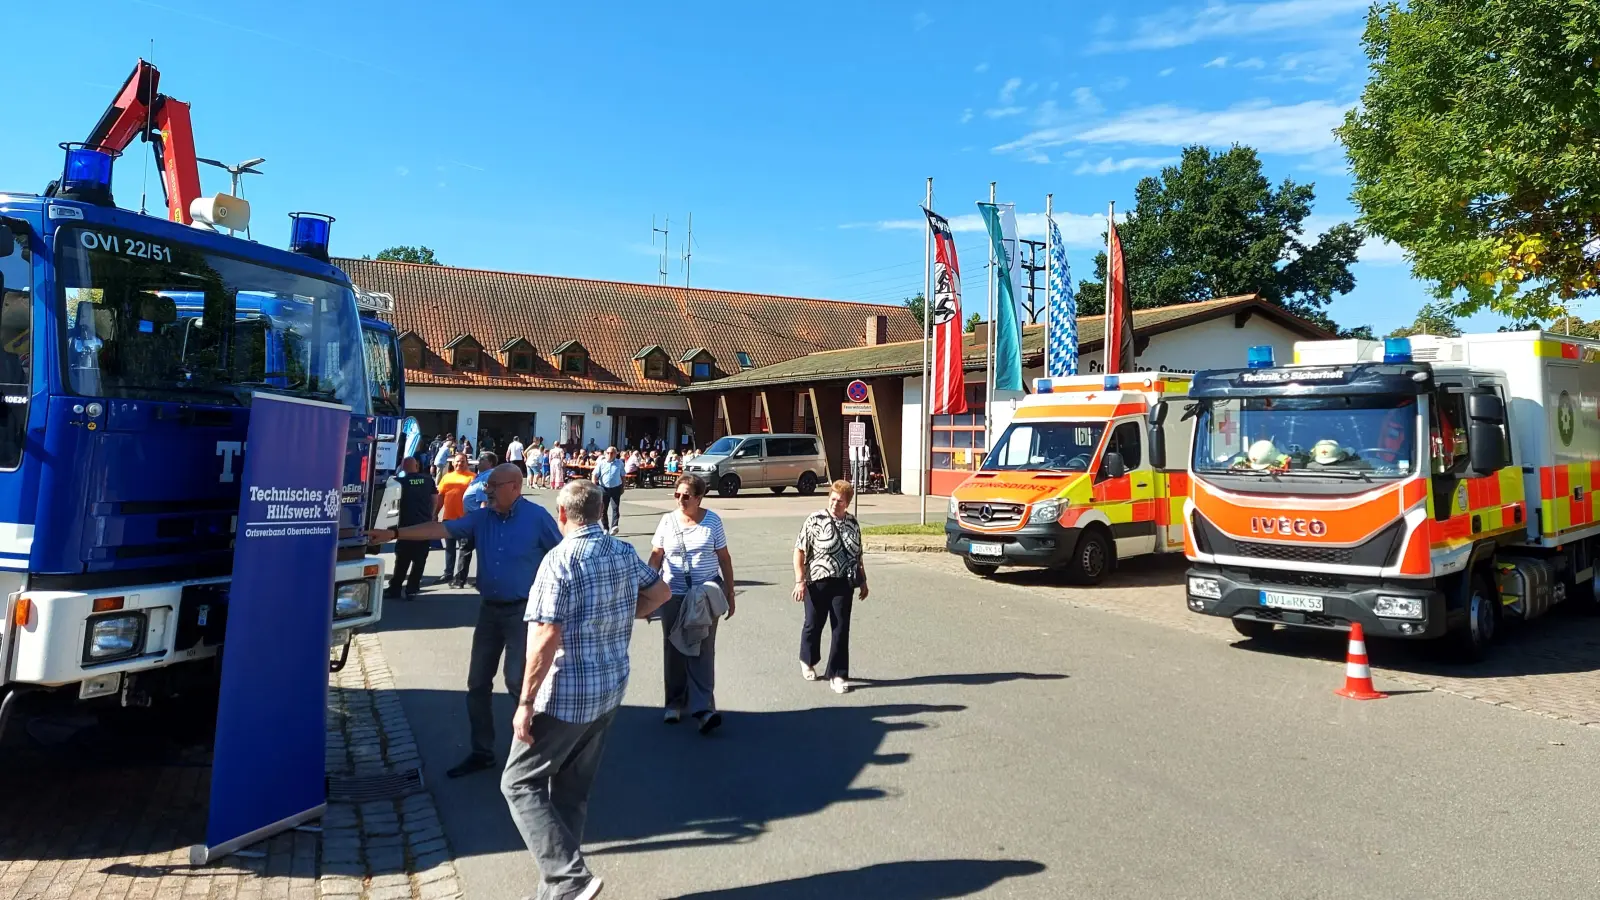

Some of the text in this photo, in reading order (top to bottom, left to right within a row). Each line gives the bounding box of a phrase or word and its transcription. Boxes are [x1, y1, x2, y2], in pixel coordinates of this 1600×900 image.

[80, 231, 171, 263] OVI 22/51
[1243, 373, 1281, 382] Technik
[1290, 371, 1344, 380] Sicherheit
[249, 486, 322, 501] Technisches
[266, 504, 321, 519] Hilfswerk
[245, 526, 331, 537] Ortsverband Oberviechtach
[1251, 516, 1327, 537] IVECO
[1267, 594, 1322, 609] OVI RK 53
